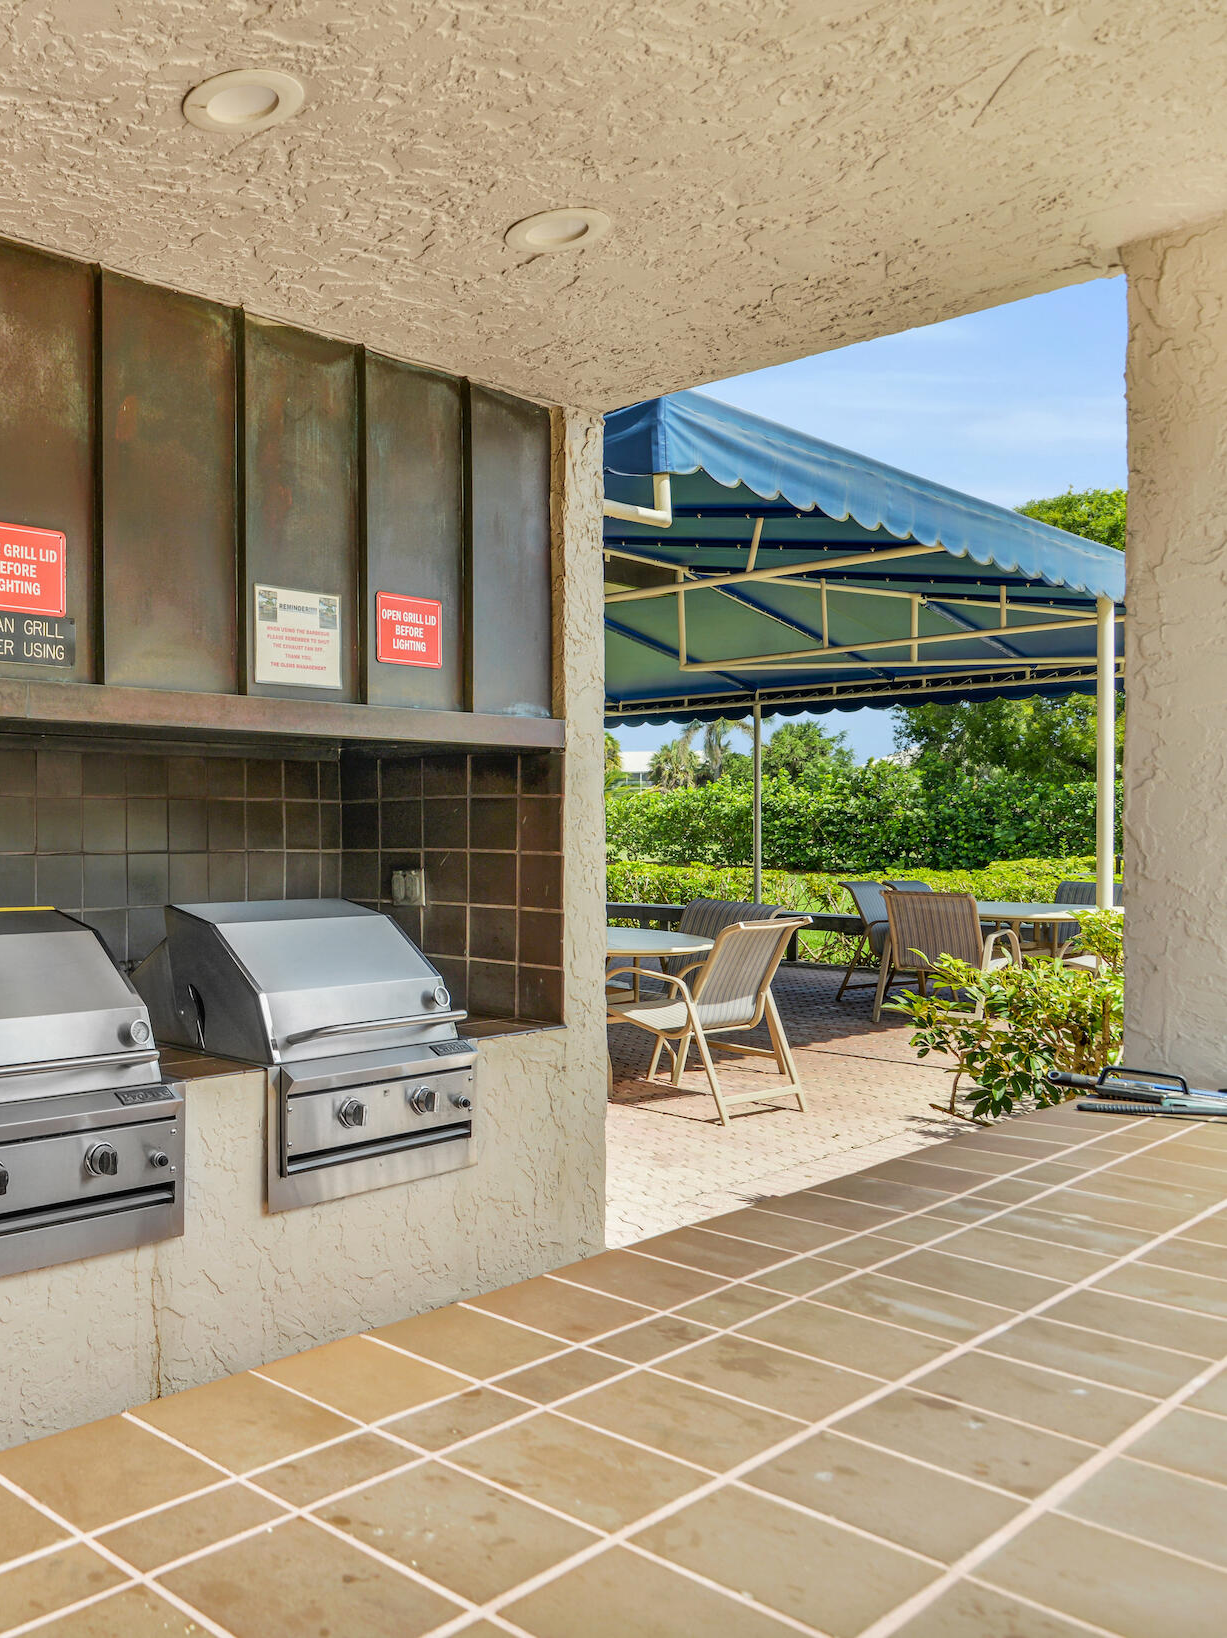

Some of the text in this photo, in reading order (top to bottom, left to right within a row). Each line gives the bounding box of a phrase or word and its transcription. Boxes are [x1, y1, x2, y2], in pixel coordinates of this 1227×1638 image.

[3, 543, 37, 561] GRILL
[39, 549, 58, 563] LID
[382, 608, 437, 626] OPEN GRILL LID
[23, 619, 64, 639] GRILL
[395, 624, 424, 638] BEFORE
[23, 642, 65, 661] USING
[392, 638, 427, 653] LIGHTING
